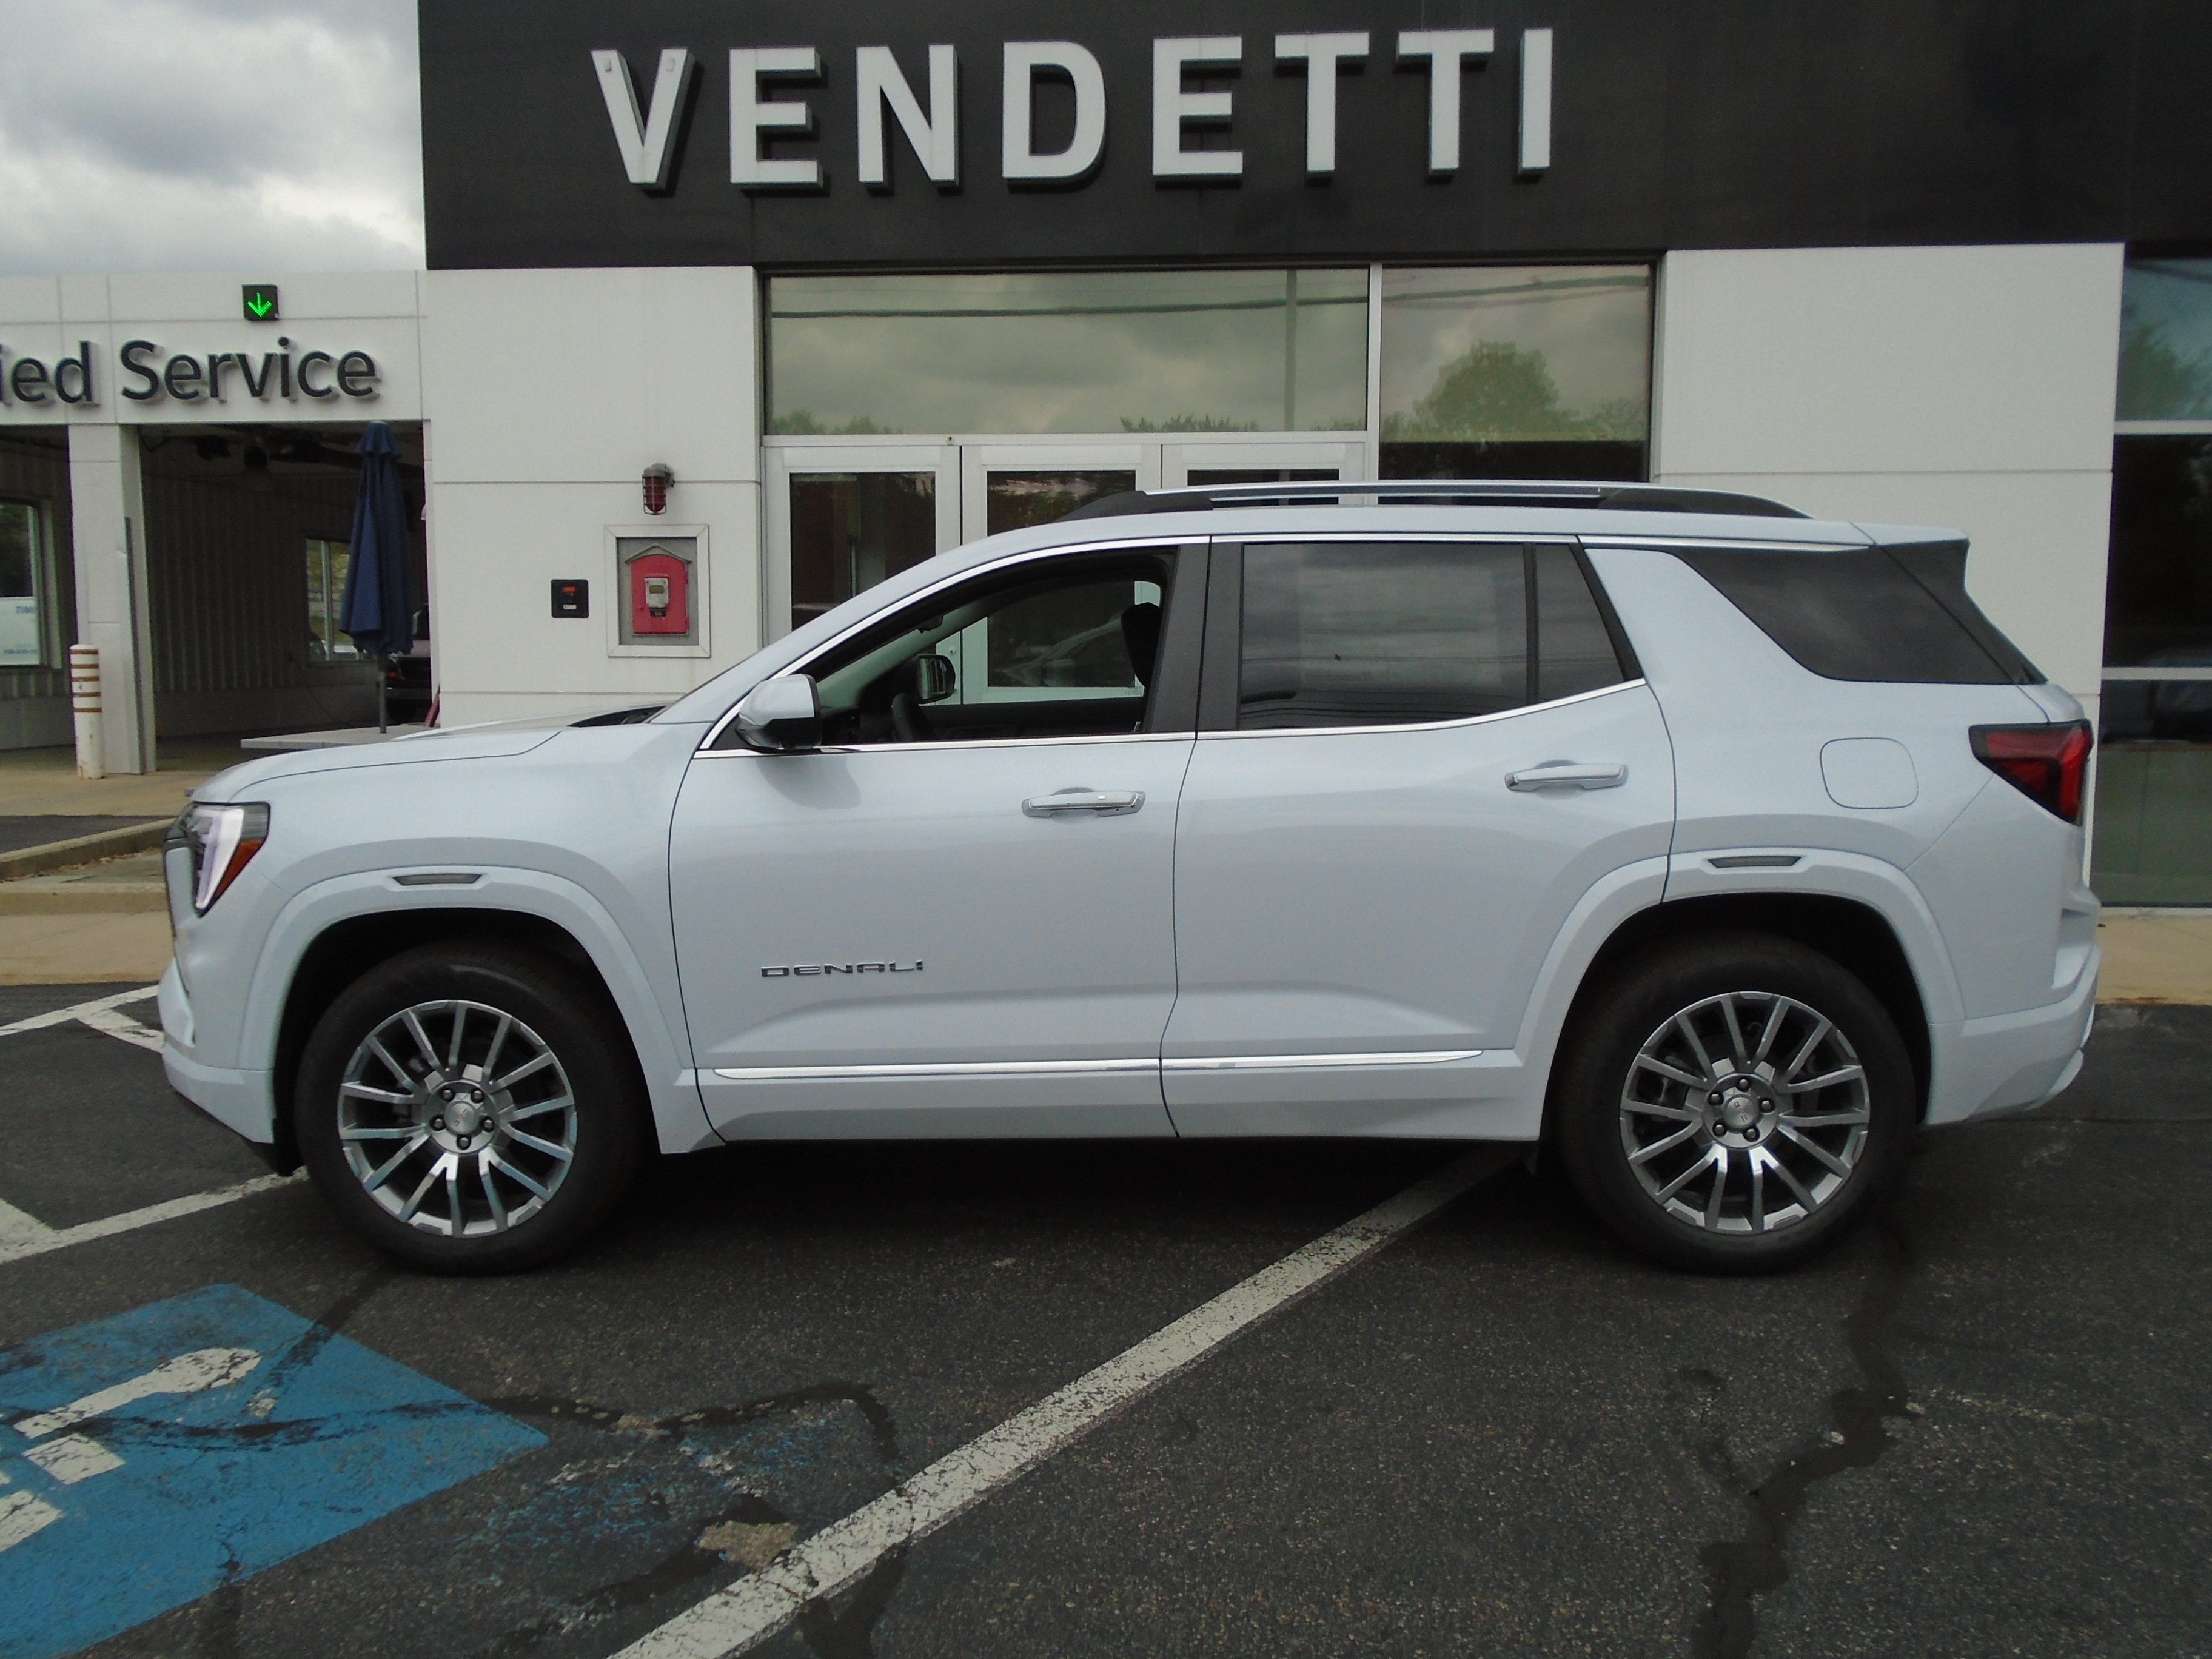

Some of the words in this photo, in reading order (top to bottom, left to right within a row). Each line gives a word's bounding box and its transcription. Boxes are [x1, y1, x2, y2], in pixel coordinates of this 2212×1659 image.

[590, 28, 1554, 187] VENDETTI
[120, 337, 376, 400] Service
[760, 959, 923, 977] DENALI
